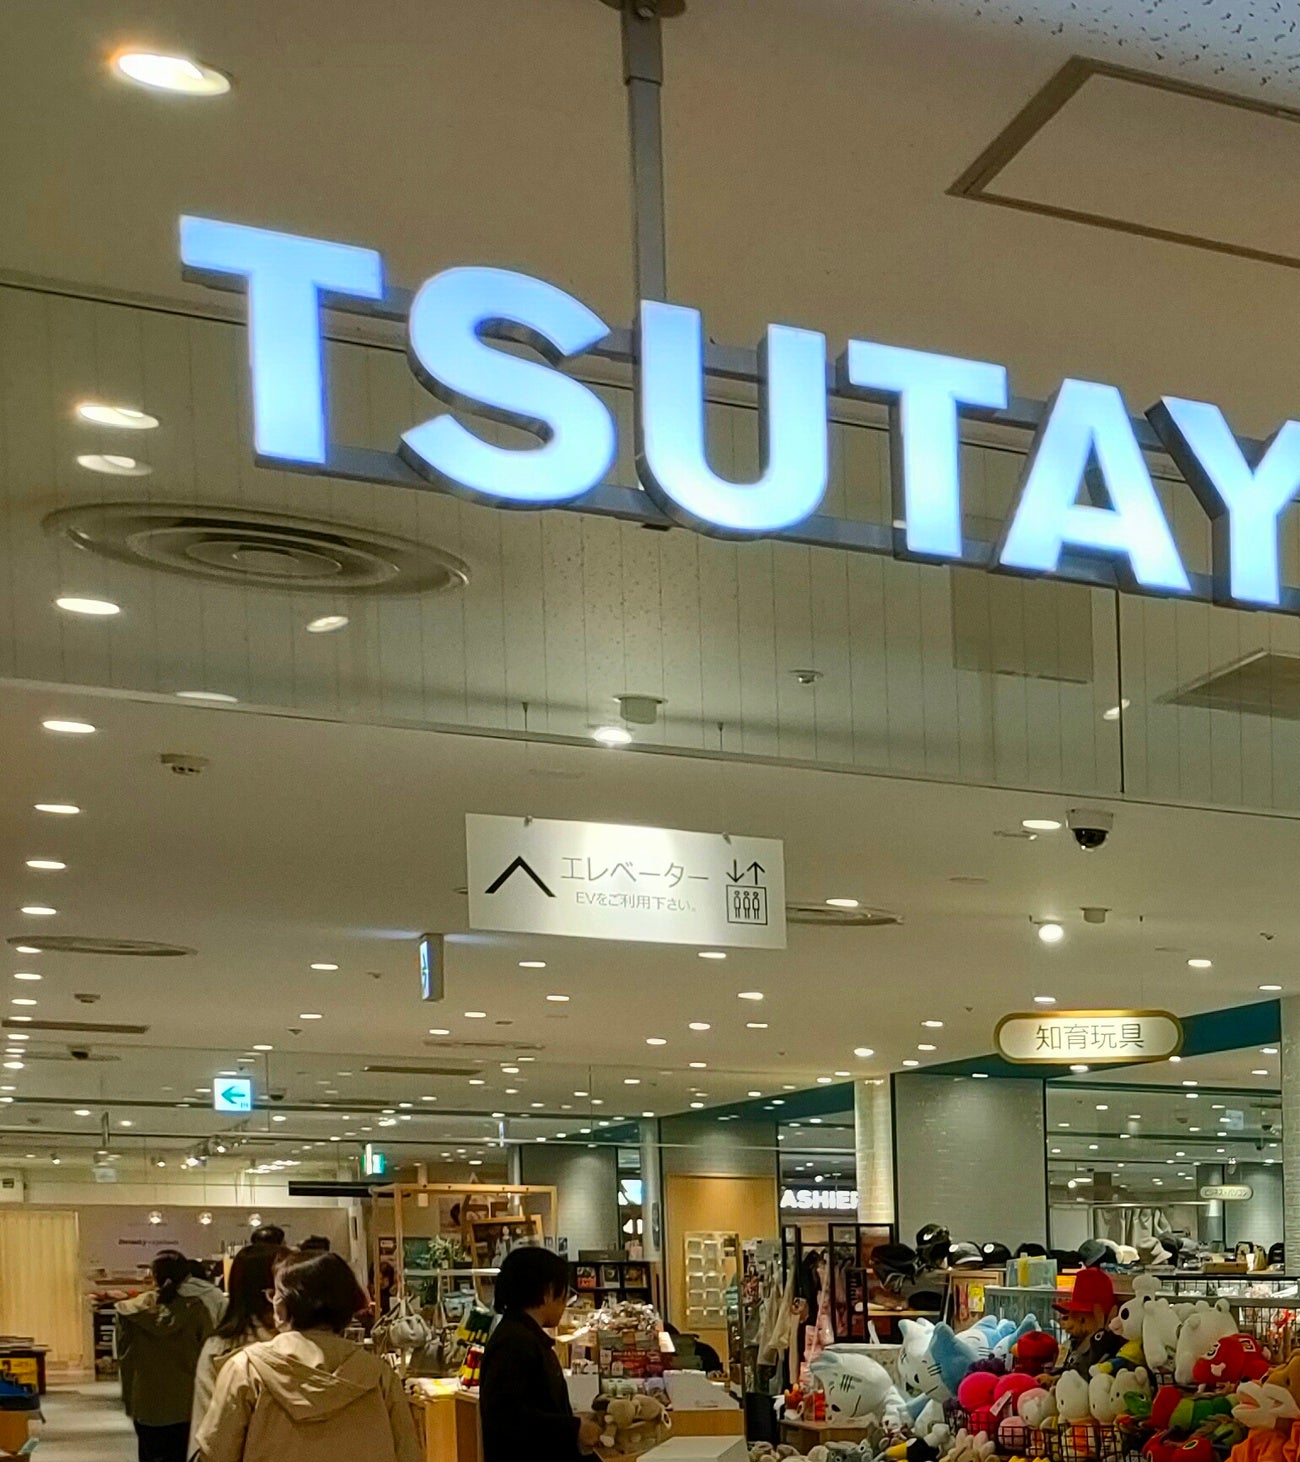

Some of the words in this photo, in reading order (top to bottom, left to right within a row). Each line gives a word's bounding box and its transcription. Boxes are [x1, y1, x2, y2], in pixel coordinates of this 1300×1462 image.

[560, 857, 709, 888] エレベーター
[576, 891, 696, 912] EVをご利用下さい。
[1036, 1023, 1145, 1050] 知育玩具
